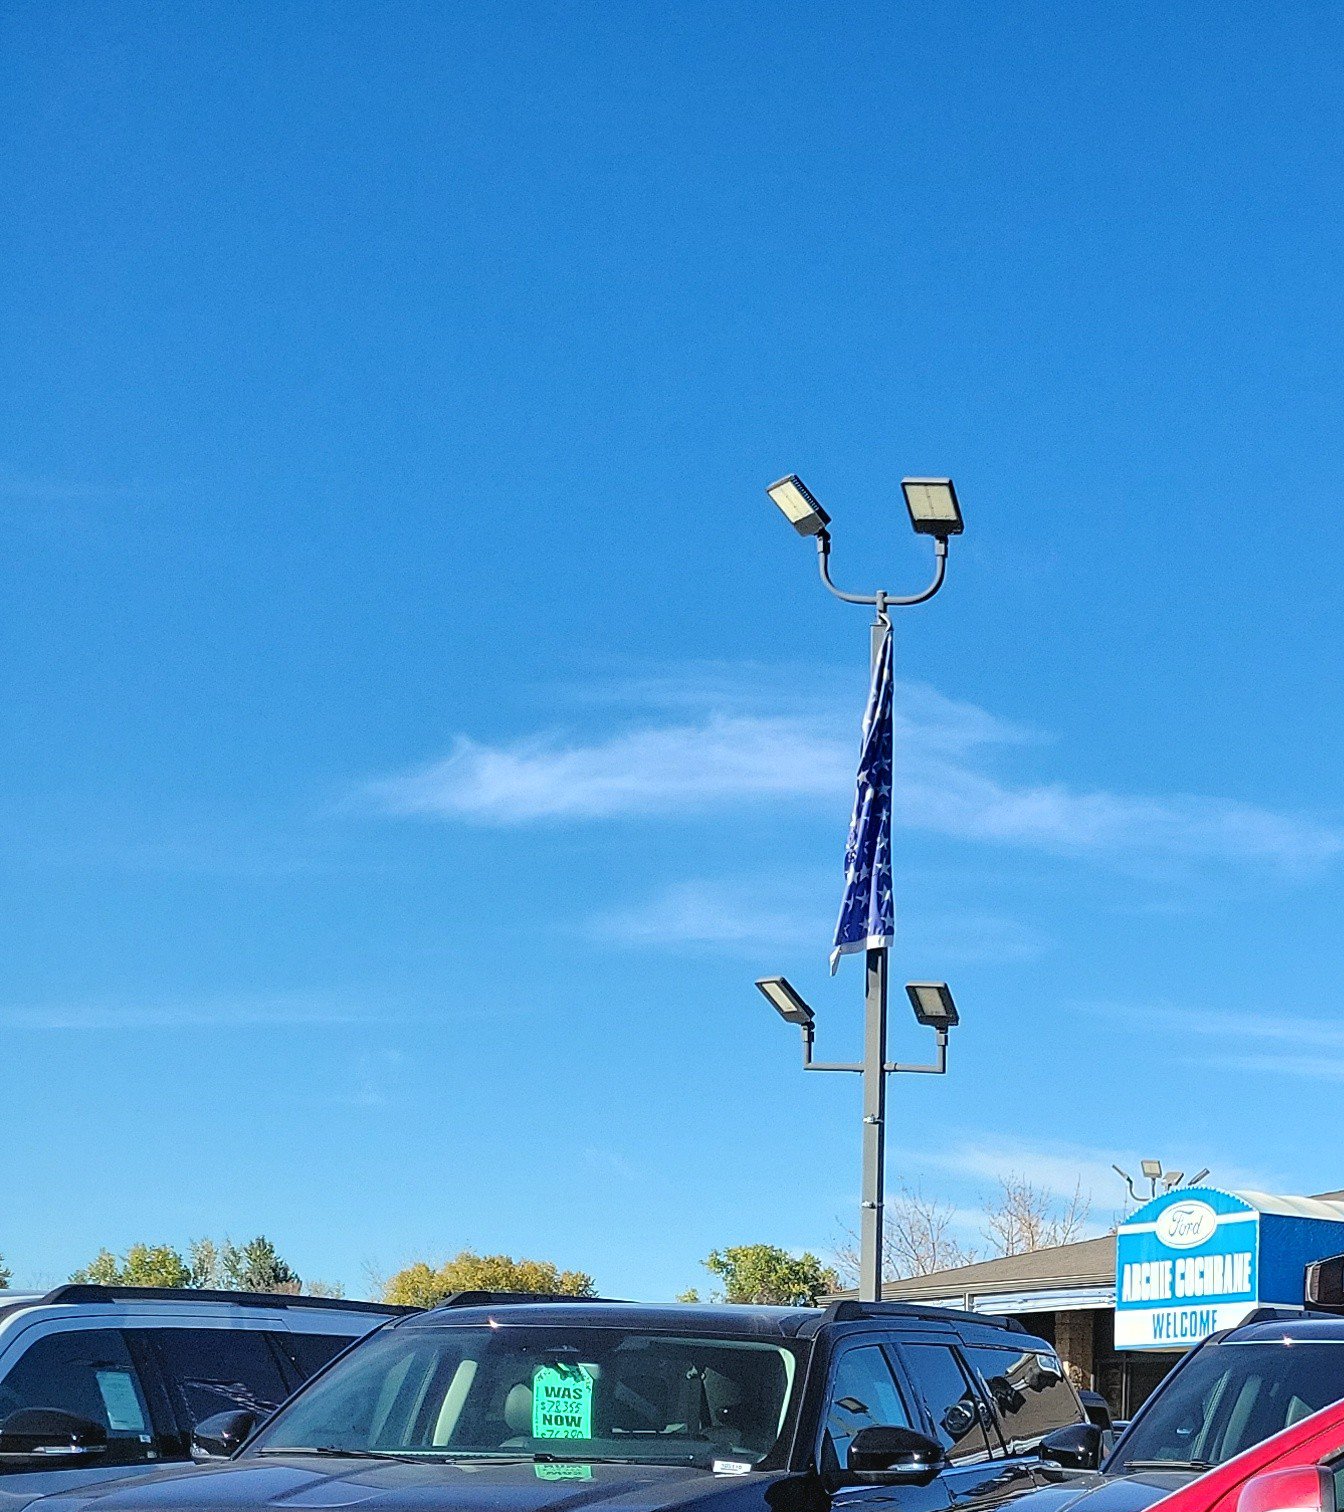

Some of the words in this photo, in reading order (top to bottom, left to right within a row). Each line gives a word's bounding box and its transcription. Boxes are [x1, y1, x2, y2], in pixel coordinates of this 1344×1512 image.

[1168, 1209, 1204, 1237] Ford
[1121, 1259, 1173, 1302] ARCHIE
[1174, 1252, 1252, 1298] COCHRANE
[1152, 1309, 1218, 1339] WELCOME
[544, 1386, 583, 1399] WAS
[542, 1413, 583, 1427] NOW
